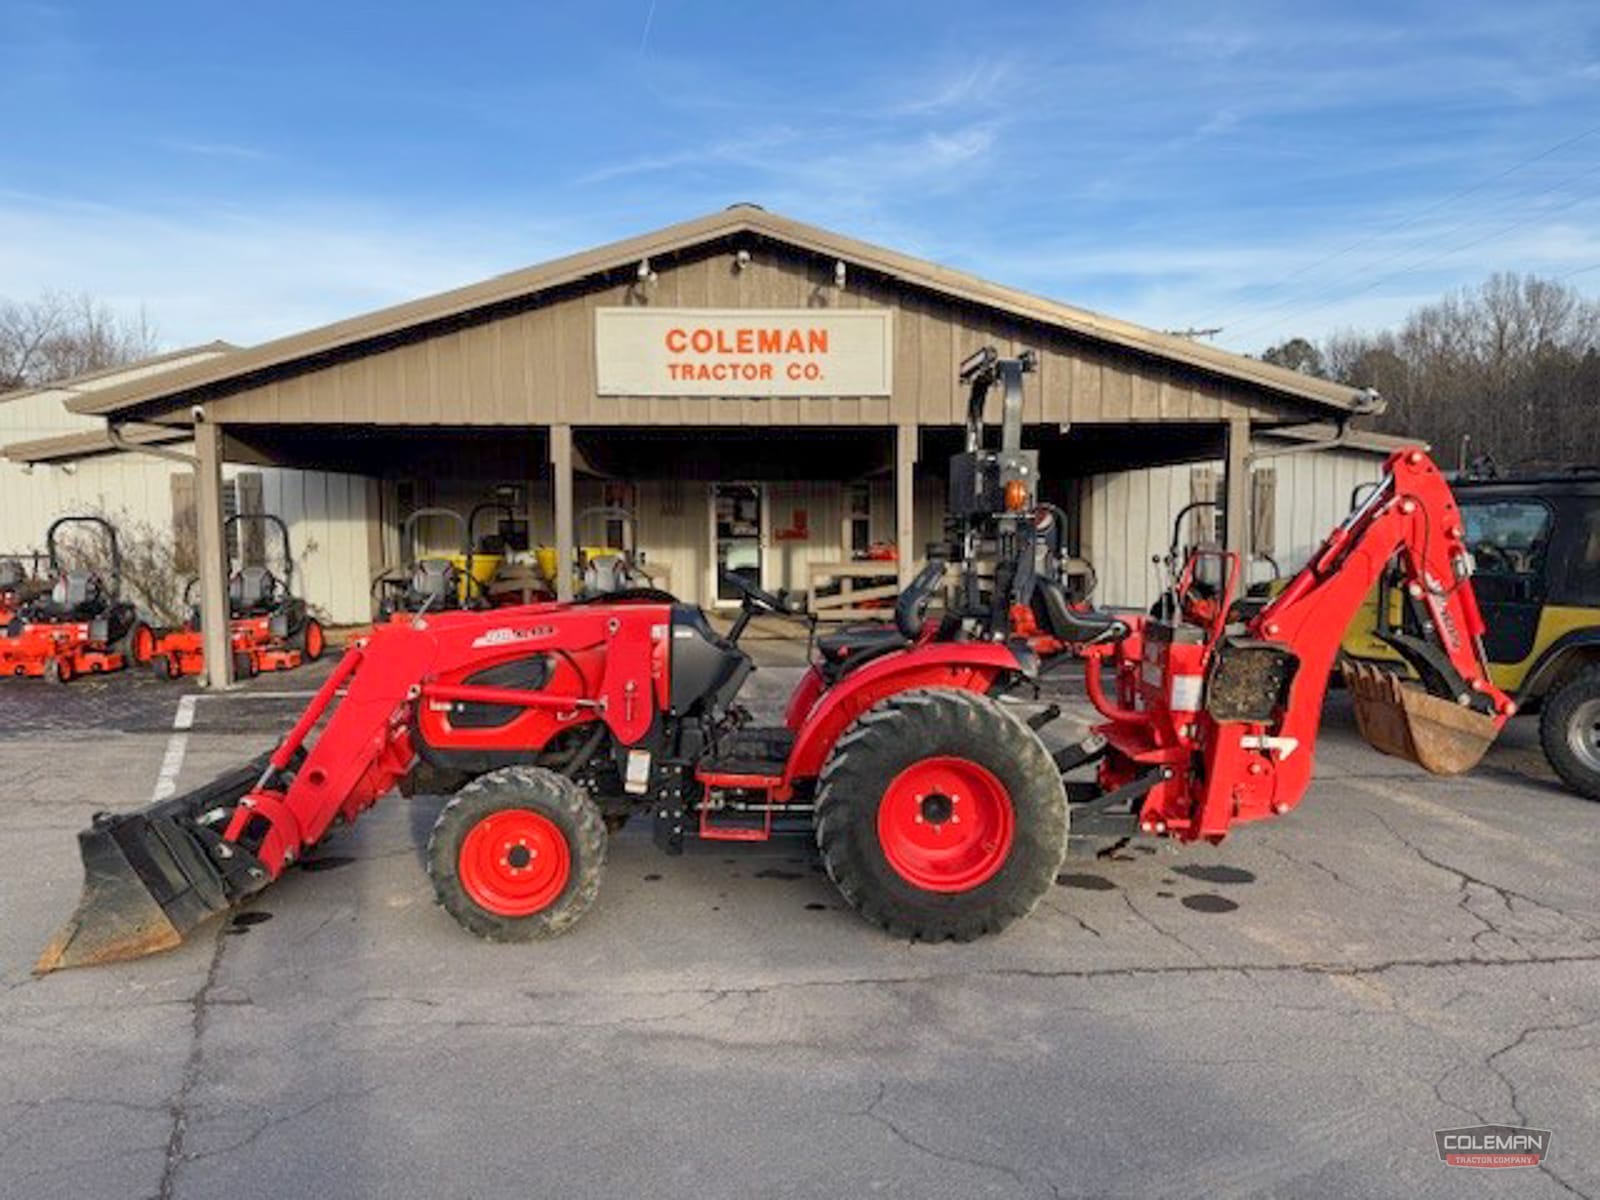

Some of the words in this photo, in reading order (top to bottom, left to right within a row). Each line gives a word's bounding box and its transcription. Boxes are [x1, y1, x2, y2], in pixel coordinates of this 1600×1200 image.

[665, 329, 828, 354] COLEMAN
[668, 363, 772, 381] TRACTOR
[787, 363, 824, 381] CO.
